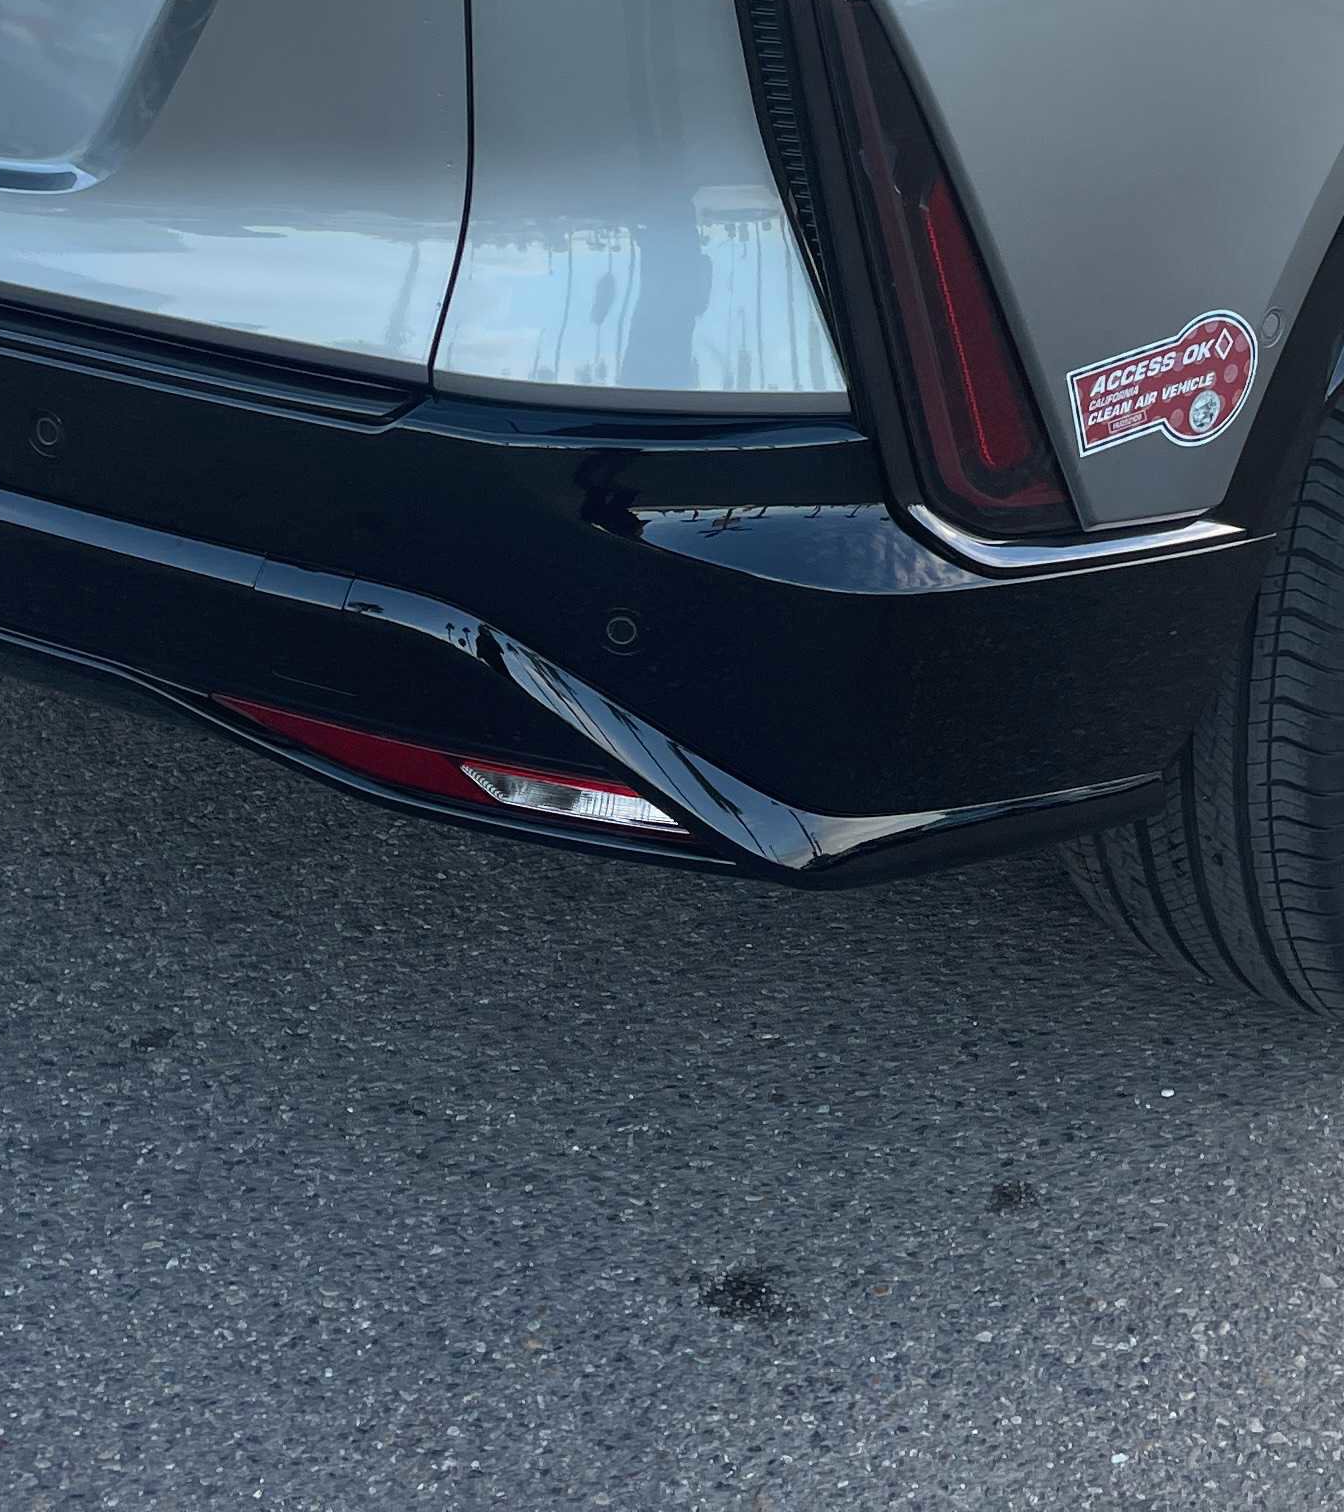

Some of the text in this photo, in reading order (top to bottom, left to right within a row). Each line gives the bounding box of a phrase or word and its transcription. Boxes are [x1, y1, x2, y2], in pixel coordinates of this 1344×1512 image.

[1090, 338, 1216, 397] ACCESS OK
[1087, 399, 1132, 425] CLEAN
[1134, 391, 1158, 410] AIR
[1162, 371, 1216, 401] VEHICLE
